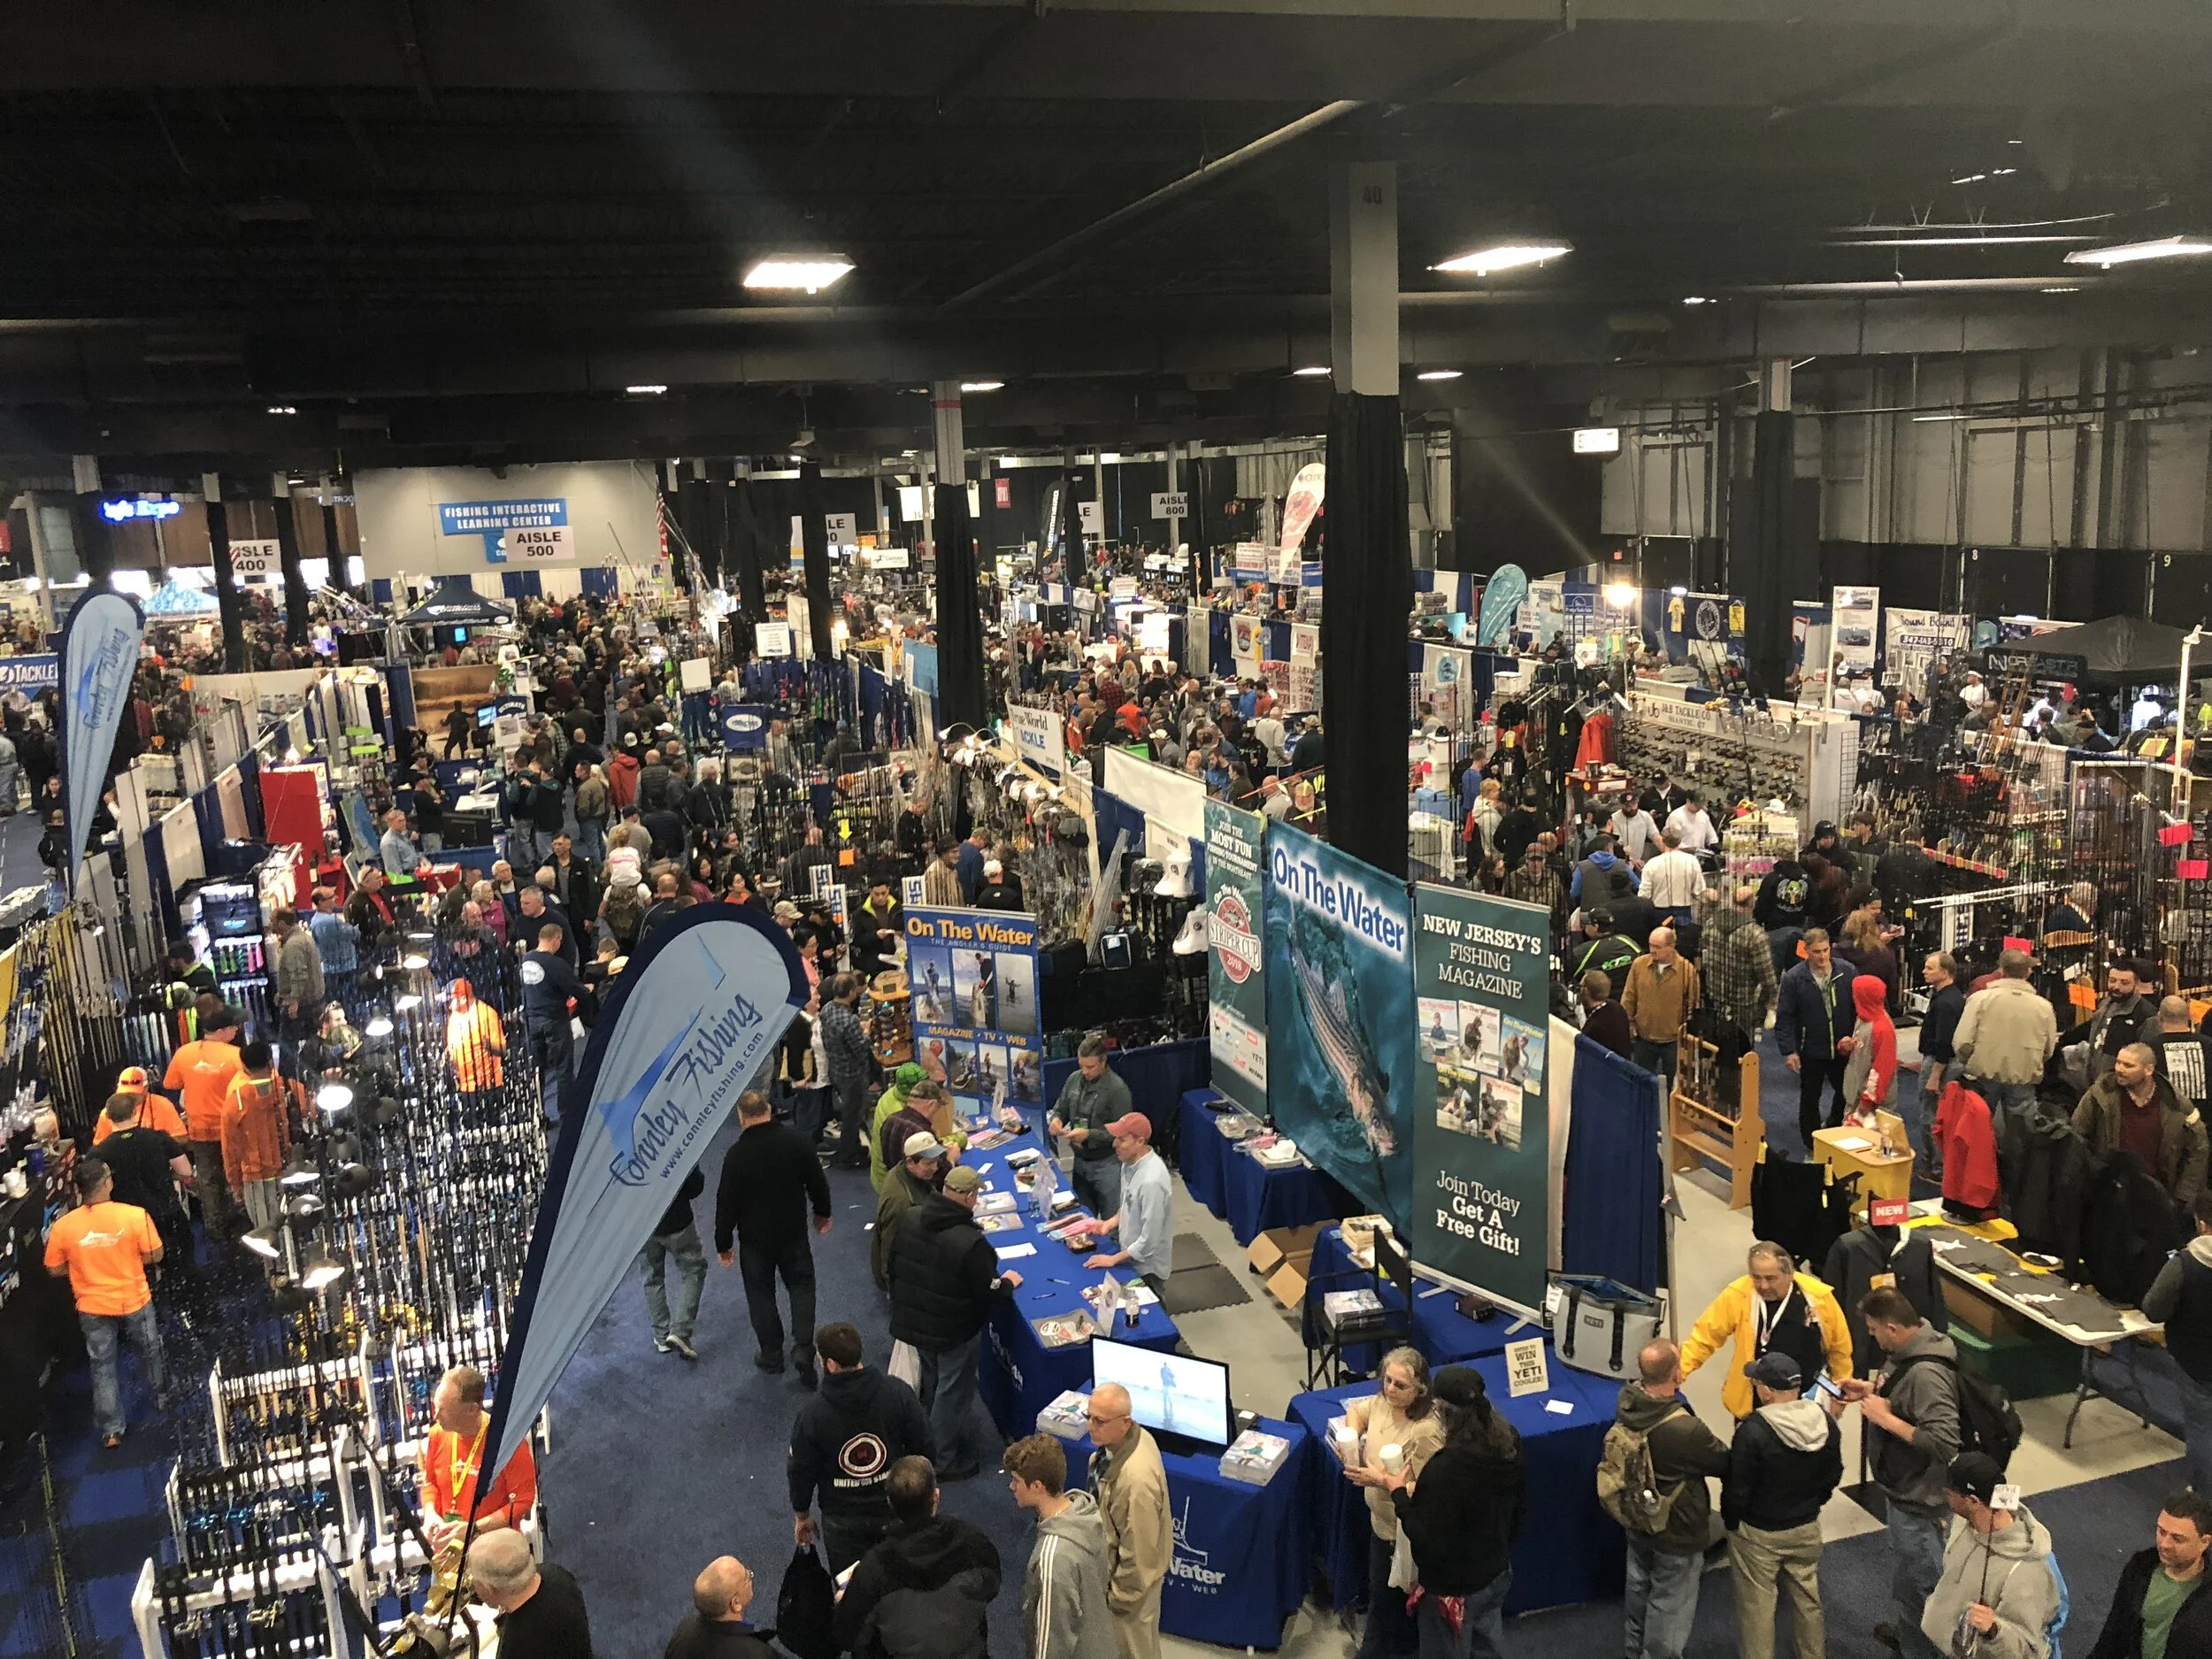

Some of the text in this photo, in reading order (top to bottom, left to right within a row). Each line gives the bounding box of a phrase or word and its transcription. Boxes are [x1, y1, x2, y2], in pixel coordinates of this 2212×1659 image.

[445, 503, 561, 518] FISHING INTERACTIVE
[1165, 506, 1185, 515] 800
[457, 515, 552, 530] LEARNING CENTER
[517, 531, 562, 544] AISLE
[238, 545, 274, 557] ISLE
[526, 545, 555, 557] 500
[1971, 549, 1978, 561] 8
[235, 559, 266, 572] 400
[2163, 554, 2171, 567] 9
[1675, 705, 1700, 719] TACKLE
[1024, 711, 1048, 731] World
[1210, 828, 1253, 859] MOST FUN
[1274, 847, 1405, 952] On The Water
[907, 916, 1034, 947] On The Water
[1423, 913, 1542, 956] NEW JERSEY'S
[931, 938, 1011, 952] THE ANGLER'S GUIDE
[1210, 922, 1260, 964] STRIPER CUP
[1448, 941, 1512, 973] FISHING
[1438, 963, 1524, 1000] MAGAZINE
[928, 1025, 1027, 1047] MAGAZINE TV WEB
[665, 993, 764, 1100] Fishing
[660, 1032, 764, 1179] www.connleyfishing.com
[1436, 1169, 1521, 1217] Join Today
[1452, 1195, 1504, 1230] Get A
[1876, 1204, 1904, 1217] NEW
[1436, 1208, 1520, 1256] Free Gift!
[1515, 1349, 1537, 1362] WIN
[1514, 1365, 1542, 1379] YETI
[833, 1478, 860, 1487] UNITED
[1192, 1583, 1217, 1594] WEB
